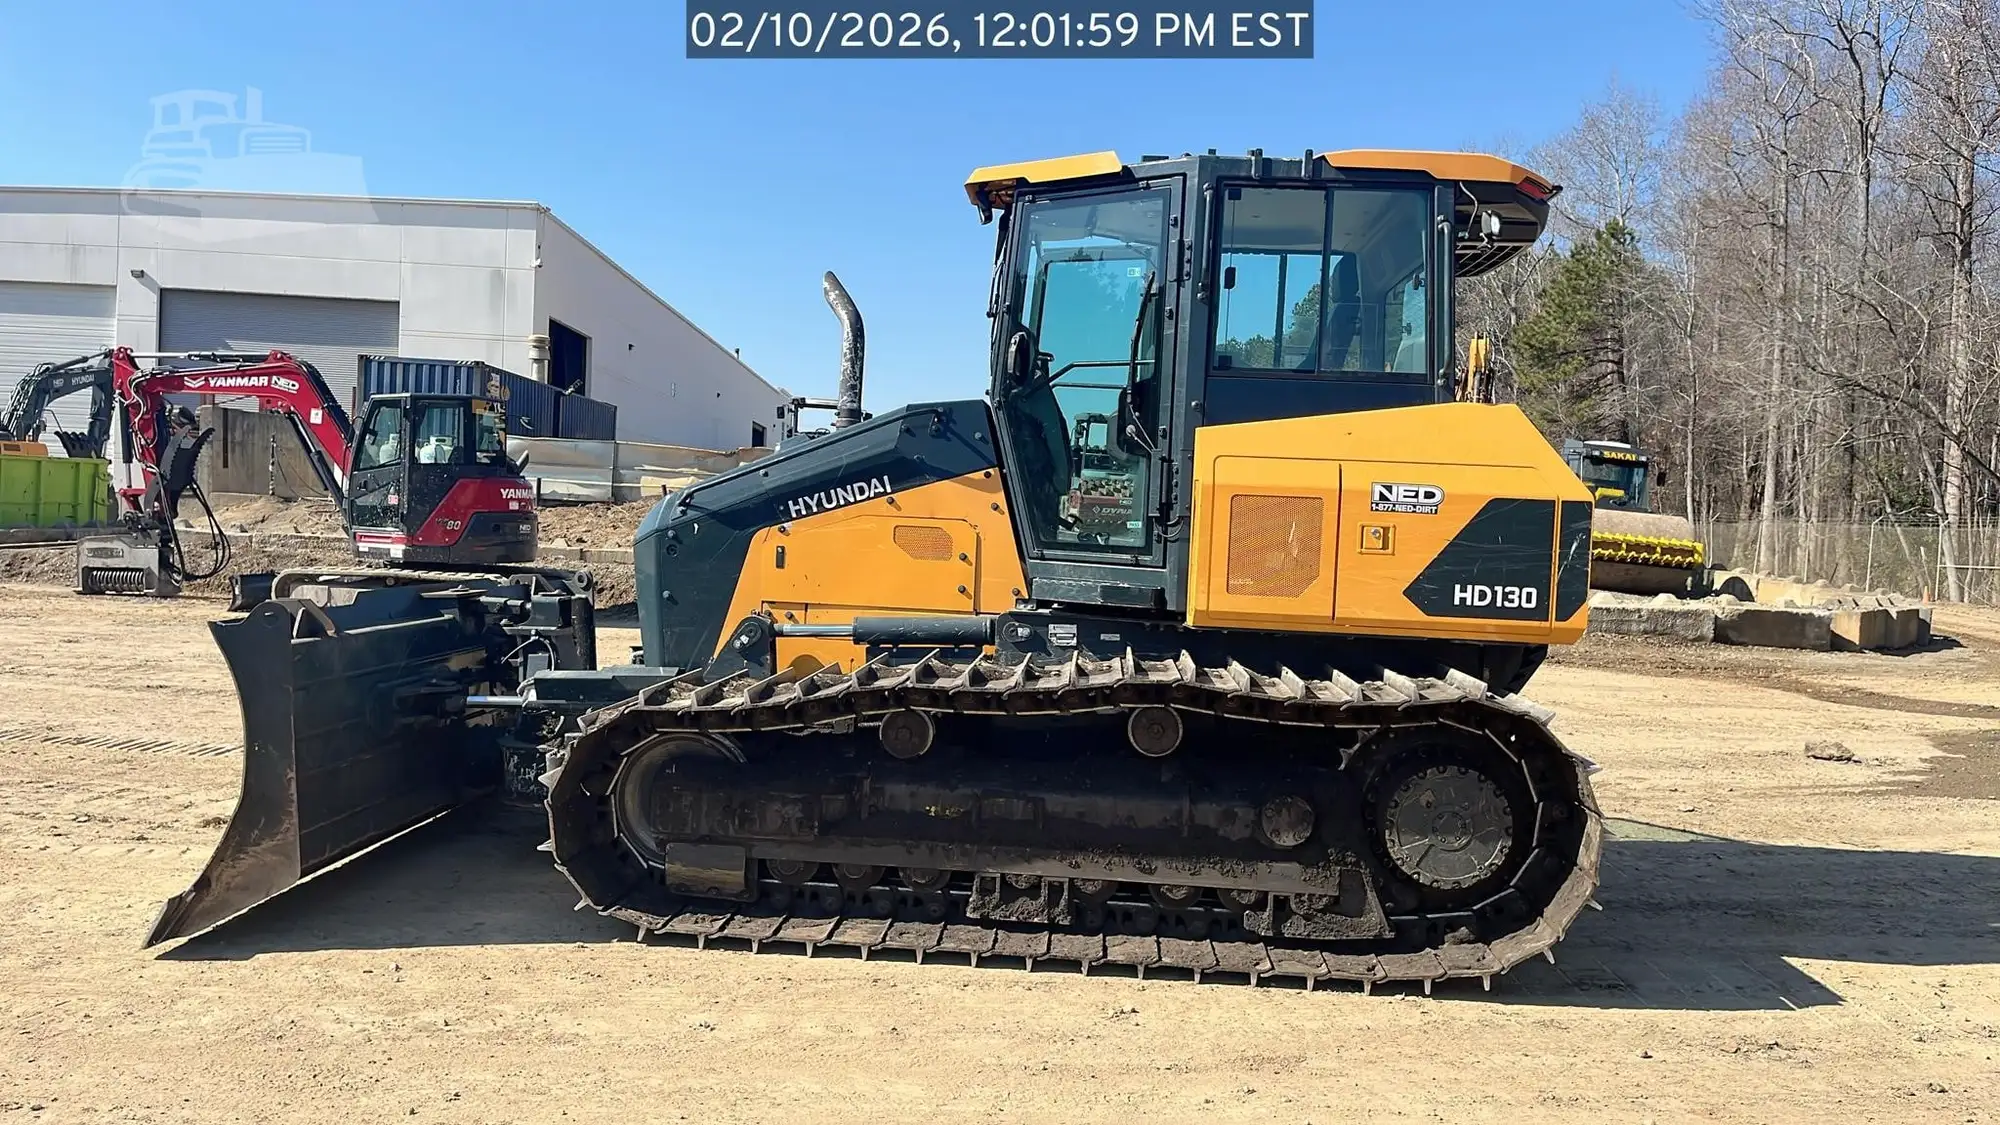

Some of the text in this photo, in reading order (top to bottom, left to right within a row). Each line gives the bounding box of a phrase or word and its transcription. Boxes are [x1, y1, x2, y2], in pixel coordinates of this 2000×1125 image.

[208, 376, 268, 387] YANMAR
[270, 375, 299, 391] NED
[1603, 450, 1637, 461] SAKAI
[787, 475, 892, 518] HYUNDAI
[1372, 483, 1444, 504] NED
[1371, 503, 1438, 514] 1-877-NED-DIRT
[1453, 583, 1538, 609] HD130
